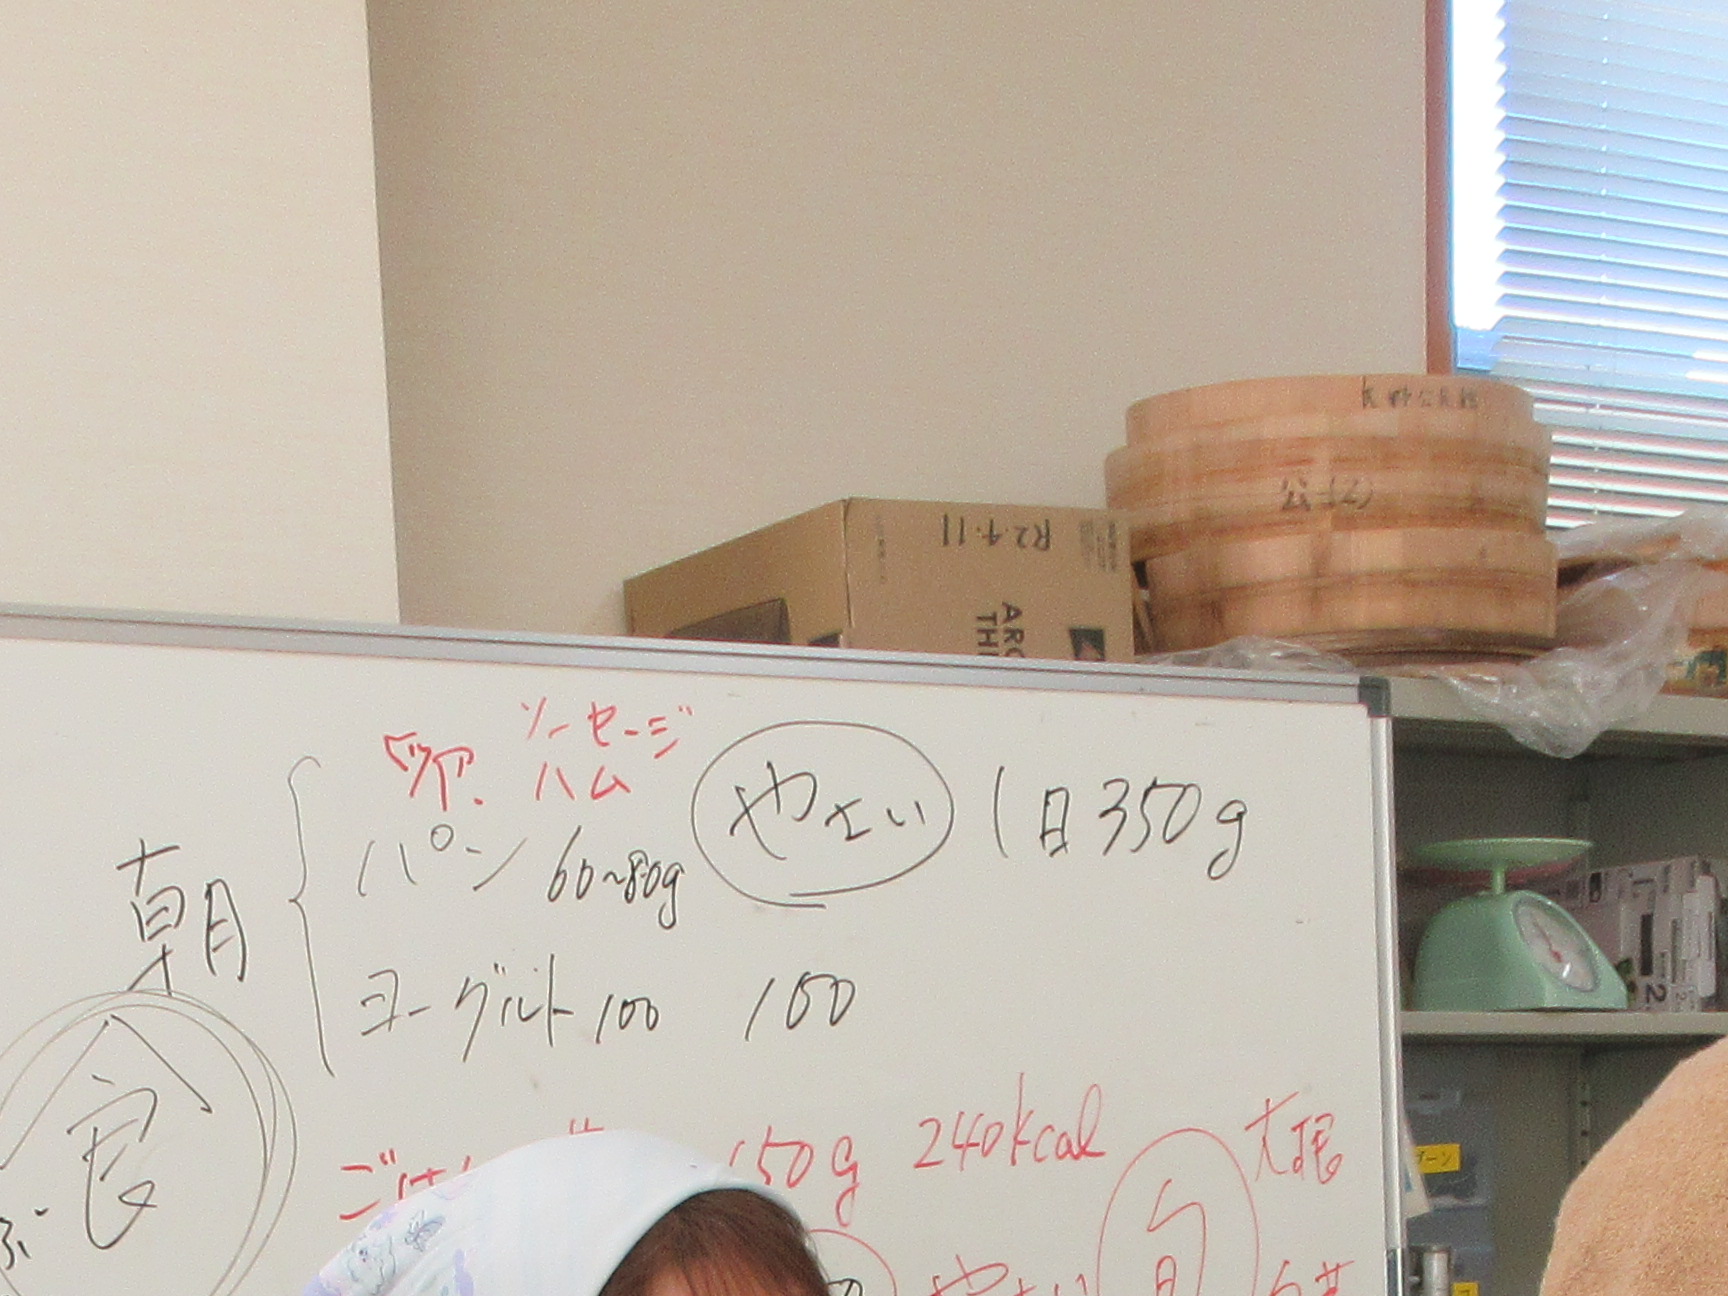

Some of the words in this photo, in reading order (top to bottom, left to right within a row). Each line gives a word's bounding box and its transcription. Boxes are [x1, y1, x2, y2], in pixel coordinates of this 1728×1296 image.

[115, 837, 248, 997] 朝
[359, 953, 575, 1063] ヨーグルト
[594, 993, 660, 1045] 100
